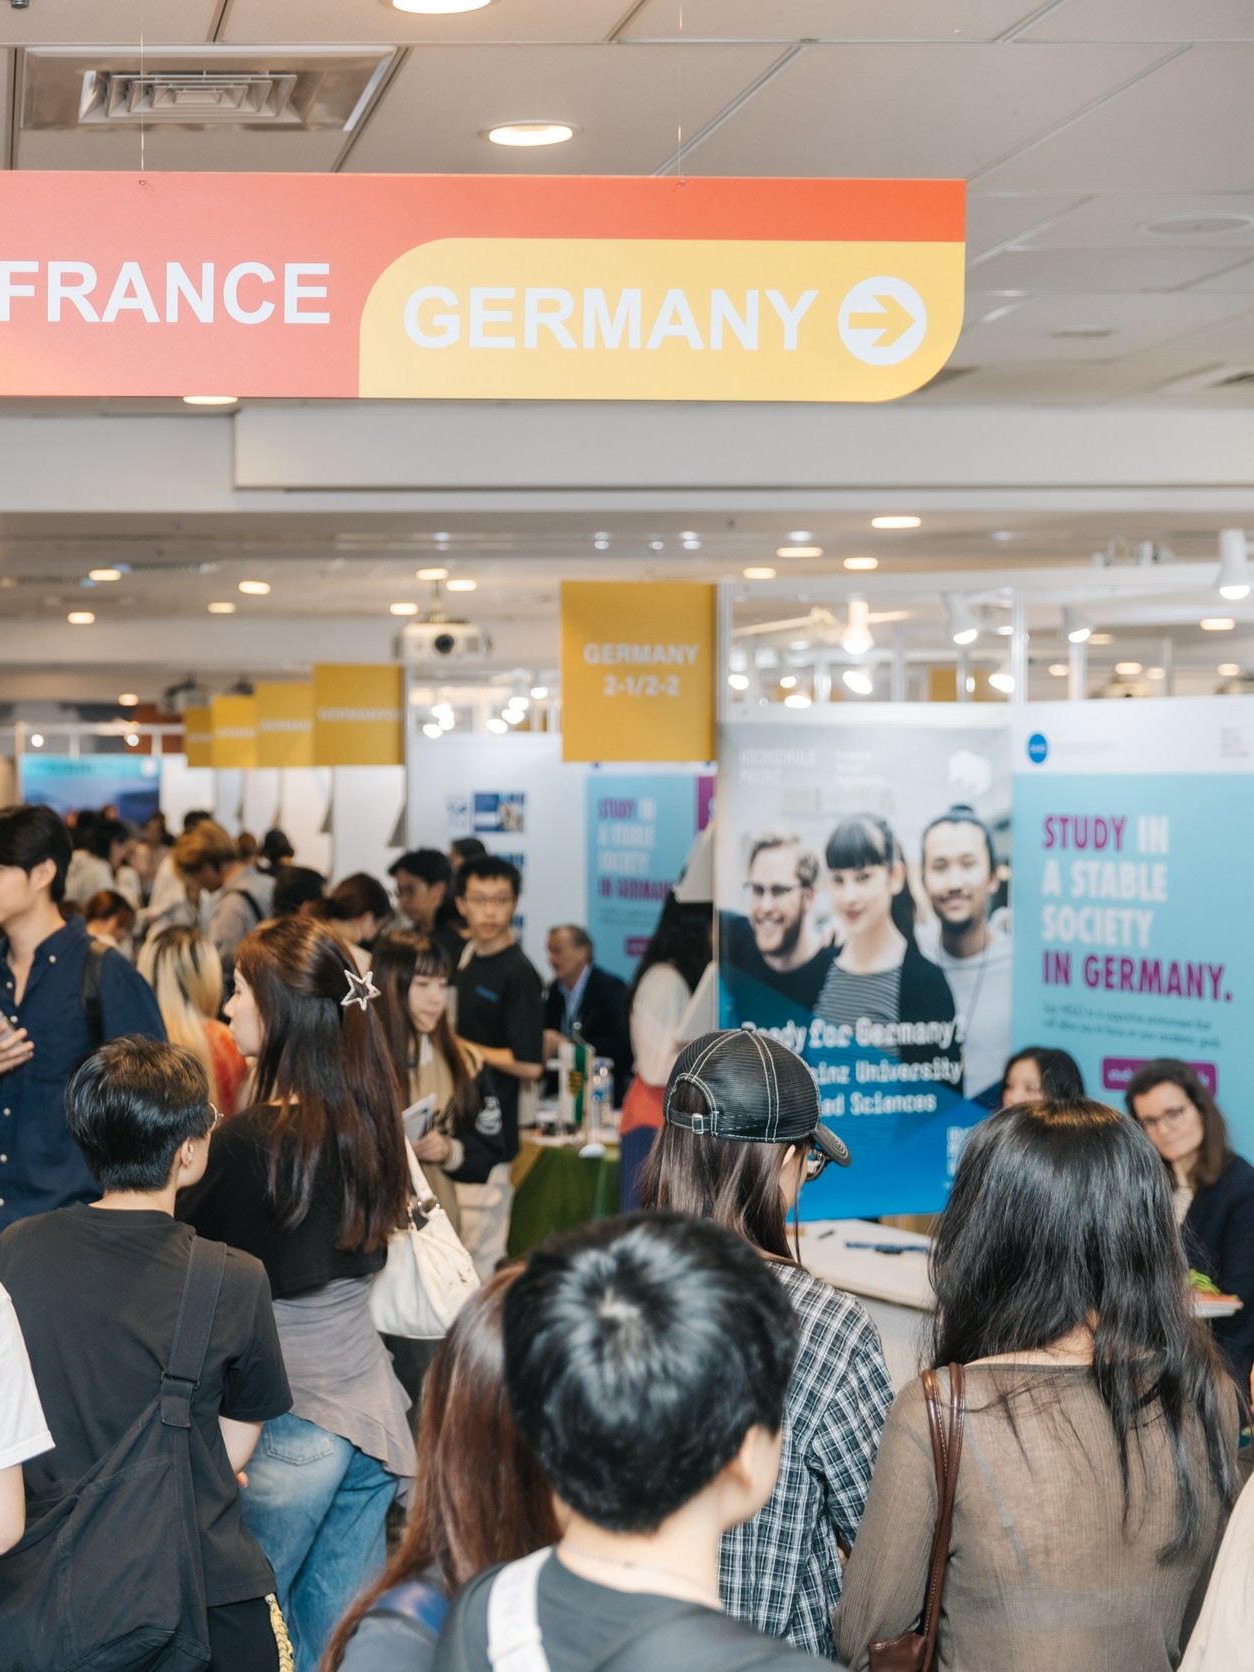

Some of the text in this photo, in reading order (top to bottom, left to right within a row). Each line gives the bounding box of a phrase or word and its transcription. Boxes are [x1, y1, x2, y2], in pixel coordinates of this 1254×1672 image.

[404, 286, 819, 350] GERMANY
[583, 642, 699, 665] GERMANY
[603, 674, 680, 697] 2-1/2-2
[1043, 815, 1169, 855] STUDY IN
[1041, 859, 1168, 902] A STABLE
[1041, 904, 1154, 948] SOCIETY
[1043, 951, 1233, 1002] IN GERMANY.
[809, 1017, 853, 1049] for
[855, 1056, 964, 1084] University
[850, 1091, 938, 1117] Sciences
